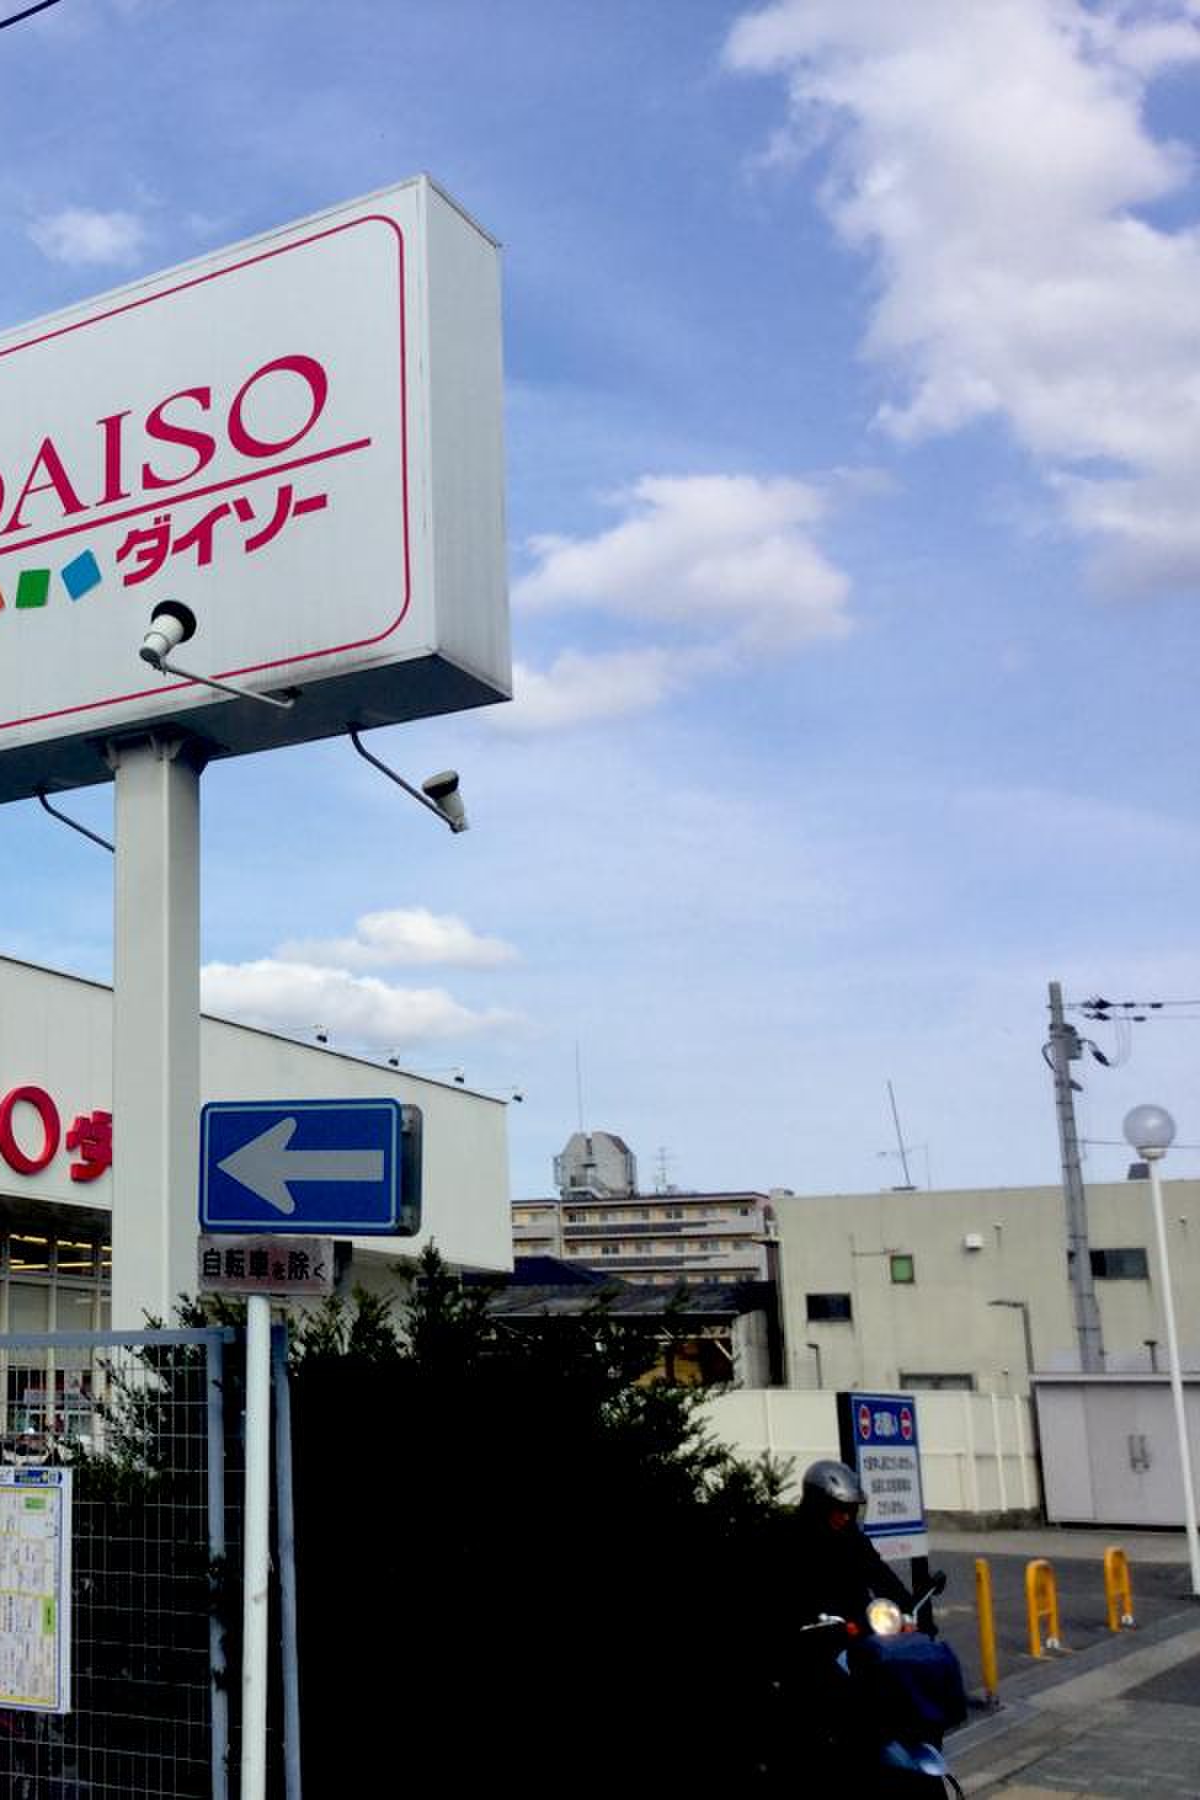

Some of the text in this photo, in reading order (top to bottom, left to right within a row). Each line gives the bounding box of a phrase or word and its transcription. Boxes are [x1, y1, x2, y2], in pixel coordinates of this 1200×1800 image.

[116, 485, 327, 586] ダイソー
[202, 1247, 326, 1282] 自転車を除く
